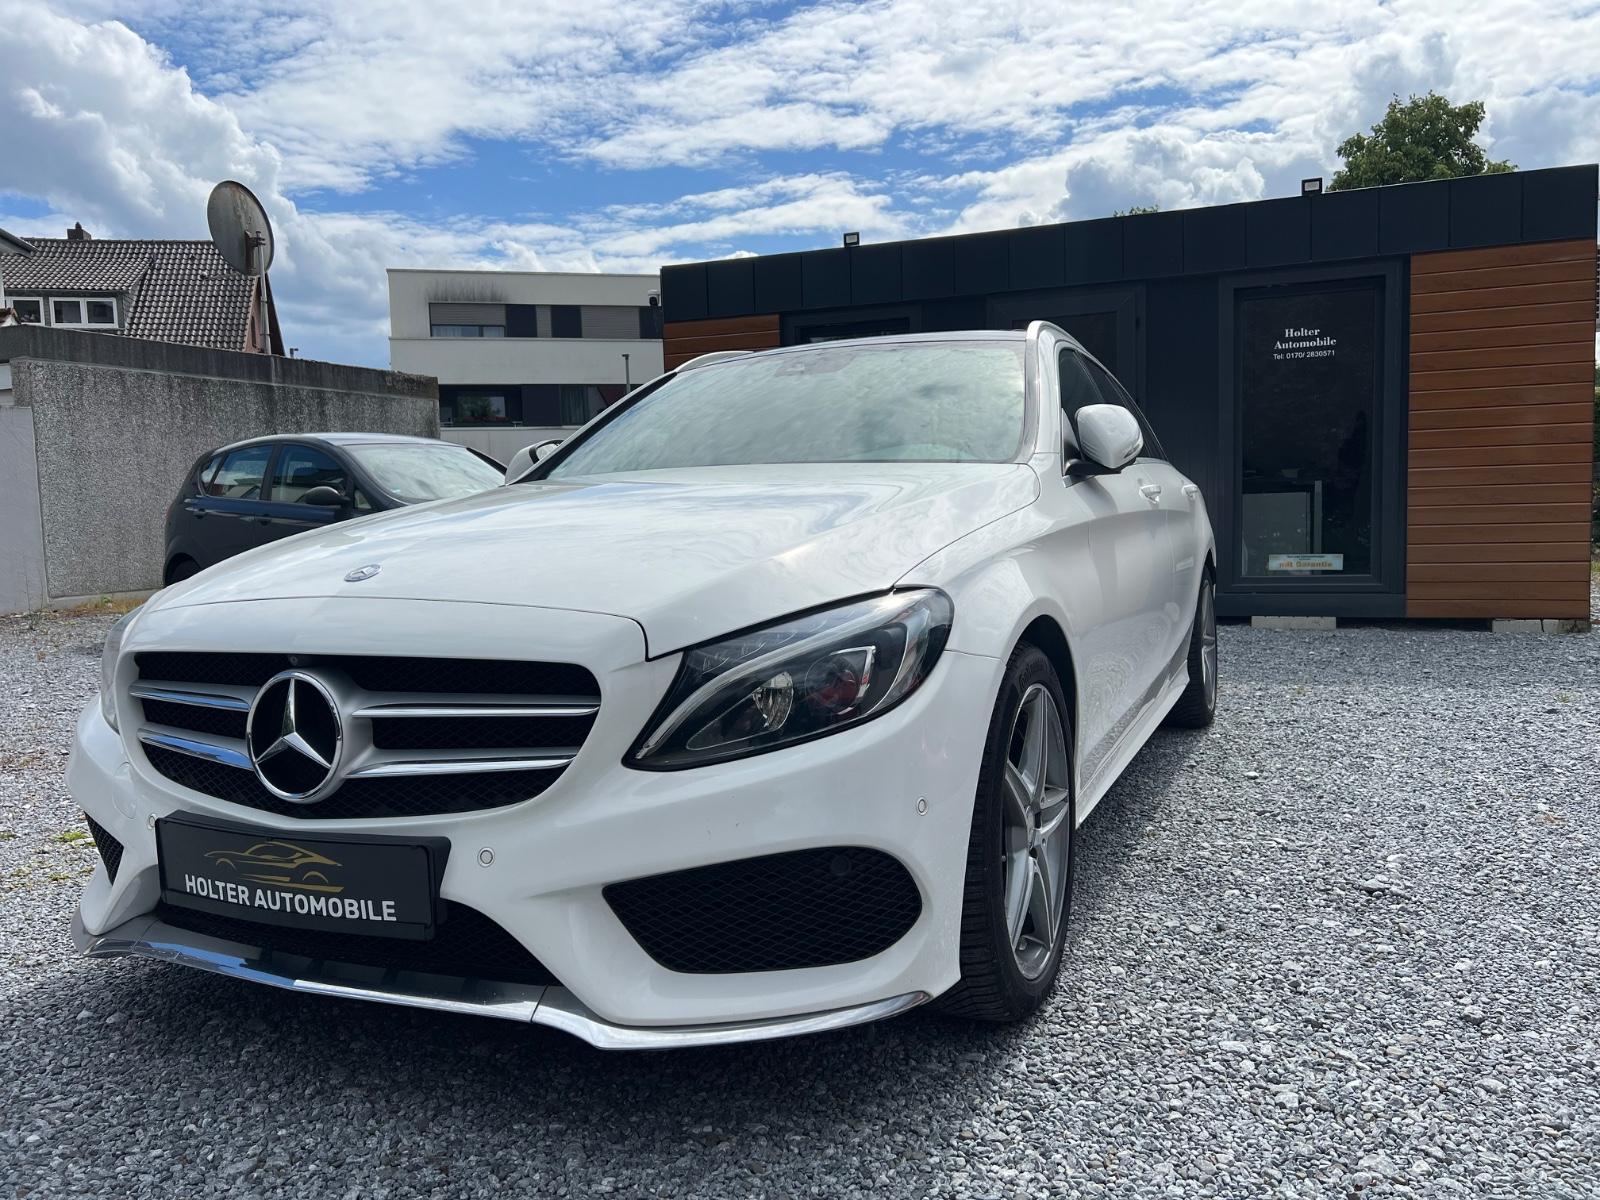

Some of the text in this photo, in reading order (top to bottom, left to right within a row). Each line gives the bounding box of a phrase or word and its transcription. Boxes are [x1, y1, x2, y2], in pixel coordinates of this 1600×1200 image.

[1285, 328, 1320, 337] Holter
[1274, 337, 1336, 349] Automobile
[1286, 351, 1305, 359] 0170/
[1306, 350, 1335, 358] 2830571
[185, 873, 397, 922] HOLTER AUTOMOBILE
